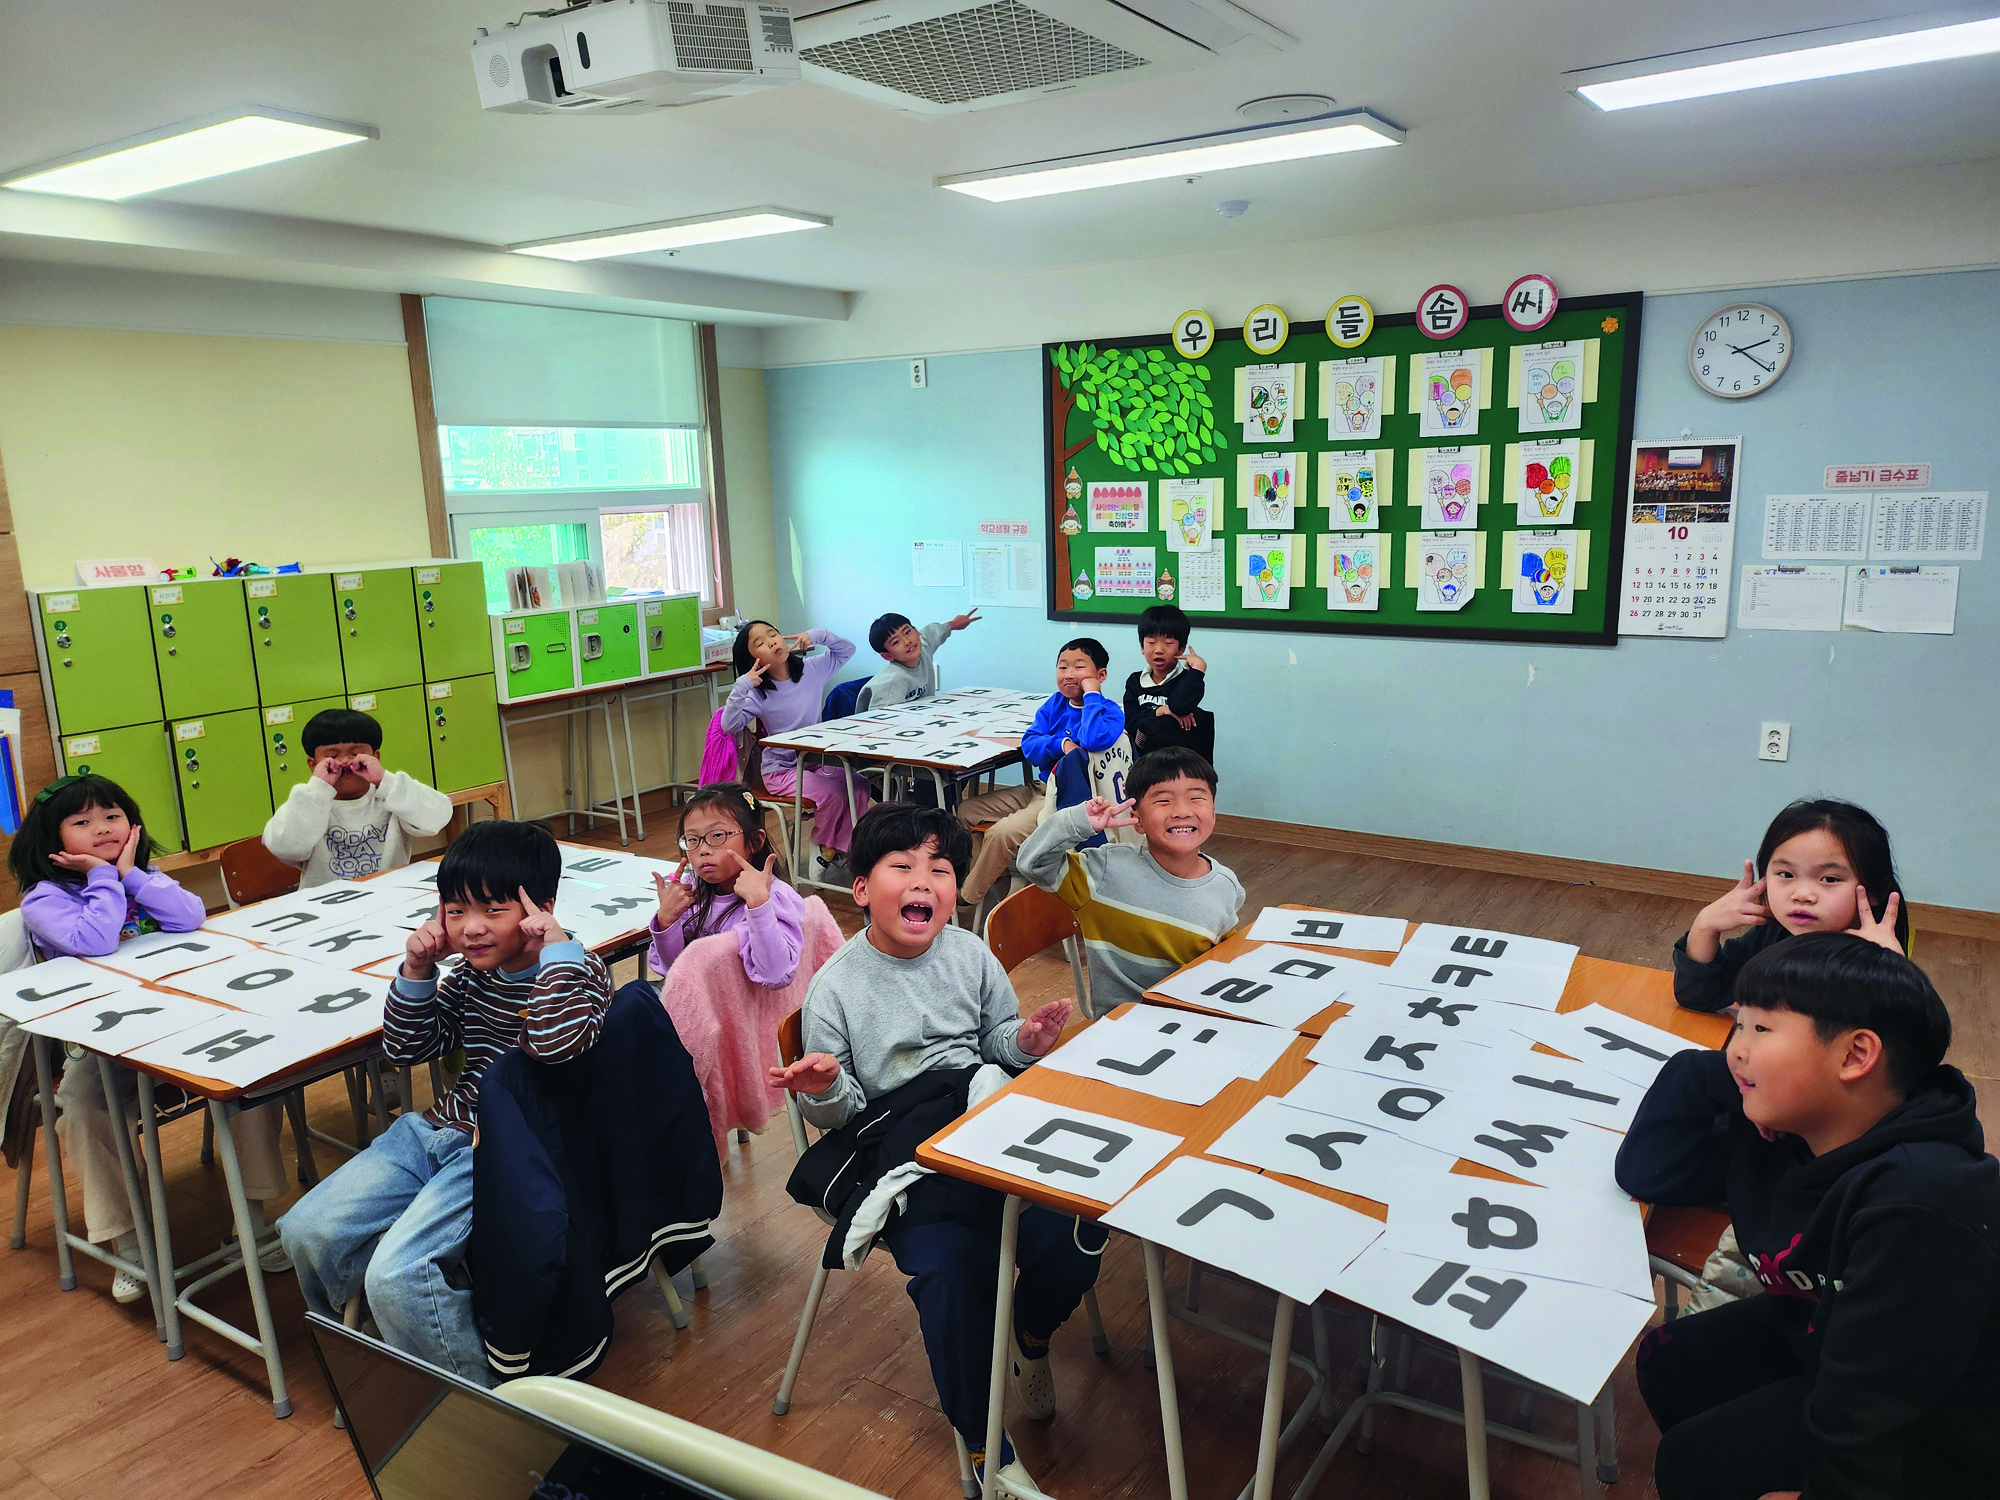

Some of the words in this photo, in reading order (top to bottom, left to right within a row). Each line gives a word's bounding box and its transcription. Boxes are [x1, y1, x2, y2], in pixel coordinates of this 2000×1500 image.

[1182, 306, 1364, 350] 우리들
[1426, 288, 1544, 328] 솜씨
[1737, 310, 1749, 320] 12
[1760, 314, 1764, 324] 1
[1719, 317, 1729, 327] 11
[1772, 325, 1779, 336] 2
[1705, 331, 1716, 341] 10
[1698, 348, 1704, 358] 9
[1777, 343, 1784, 353] 3
[1702, 365, 1710, 375] 8
[1769, 361, 1776, 371] 4
[1717, 377, 1724, 387] 7
[1754, 375, 1760, 385] 5
[1734, 380, 1740, 391] 6
[1835, 470, 1875, 483] 줄넘기
[1879, 469, 1919, 482] 급수표
[981, 524, 1010, 533] 학교생활
[1012, 524, 1027, 534] 규정
[1668, 526, 1688, 539] 10
[95, 564, 145, 578] 사물함
[327, 823, 389, 847] ODAY
[226, 968, 295, 991] ㅇ
[1378, 1087, 1446, 1121] ㅇ
